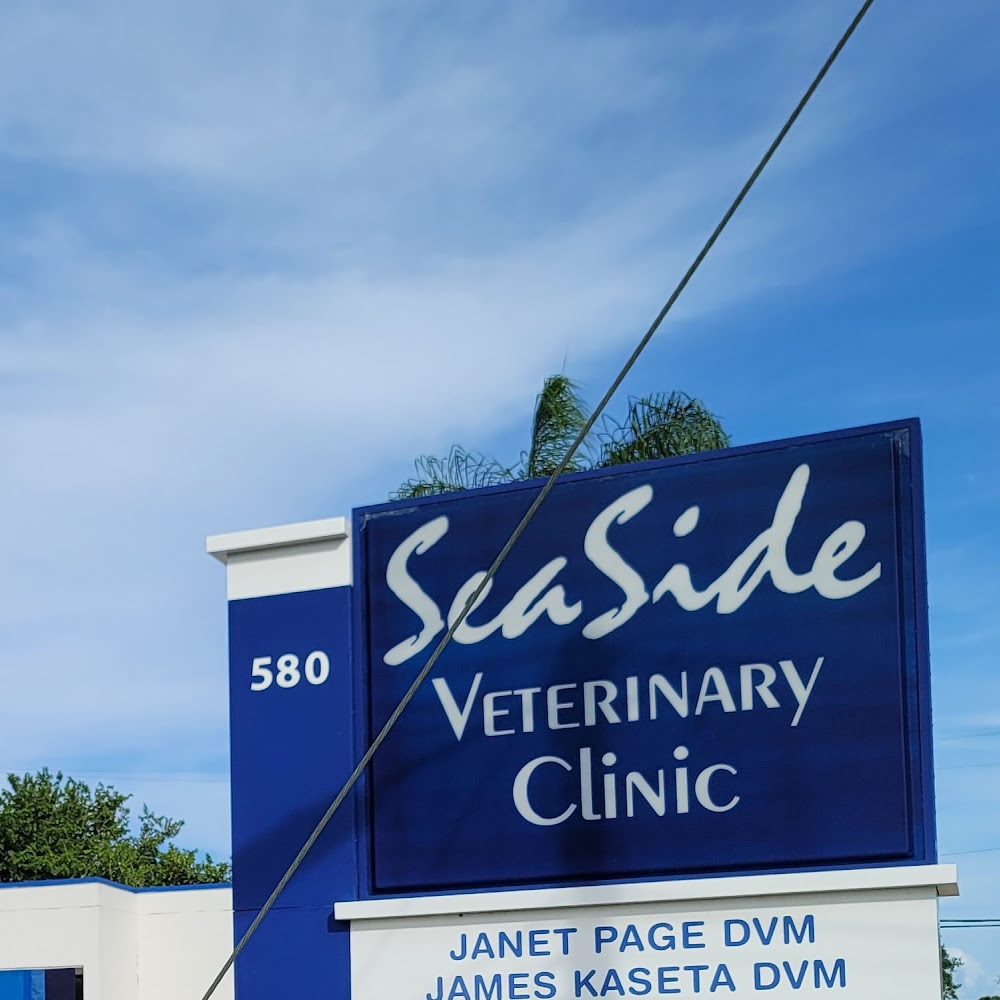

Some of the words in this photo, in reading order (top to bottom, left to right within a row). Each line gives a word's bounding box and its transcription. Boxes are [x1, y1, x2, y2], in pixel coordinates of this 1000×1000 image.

[250, 651, 330, 692] 580
[449, 927, 578, 962] JANET
[594, 920, 706, 954] PAGE
[723, 914, 816, 948] DVM
[574, 963, 736, 998] KASETA
[753, 958, 847, 991] DVM
